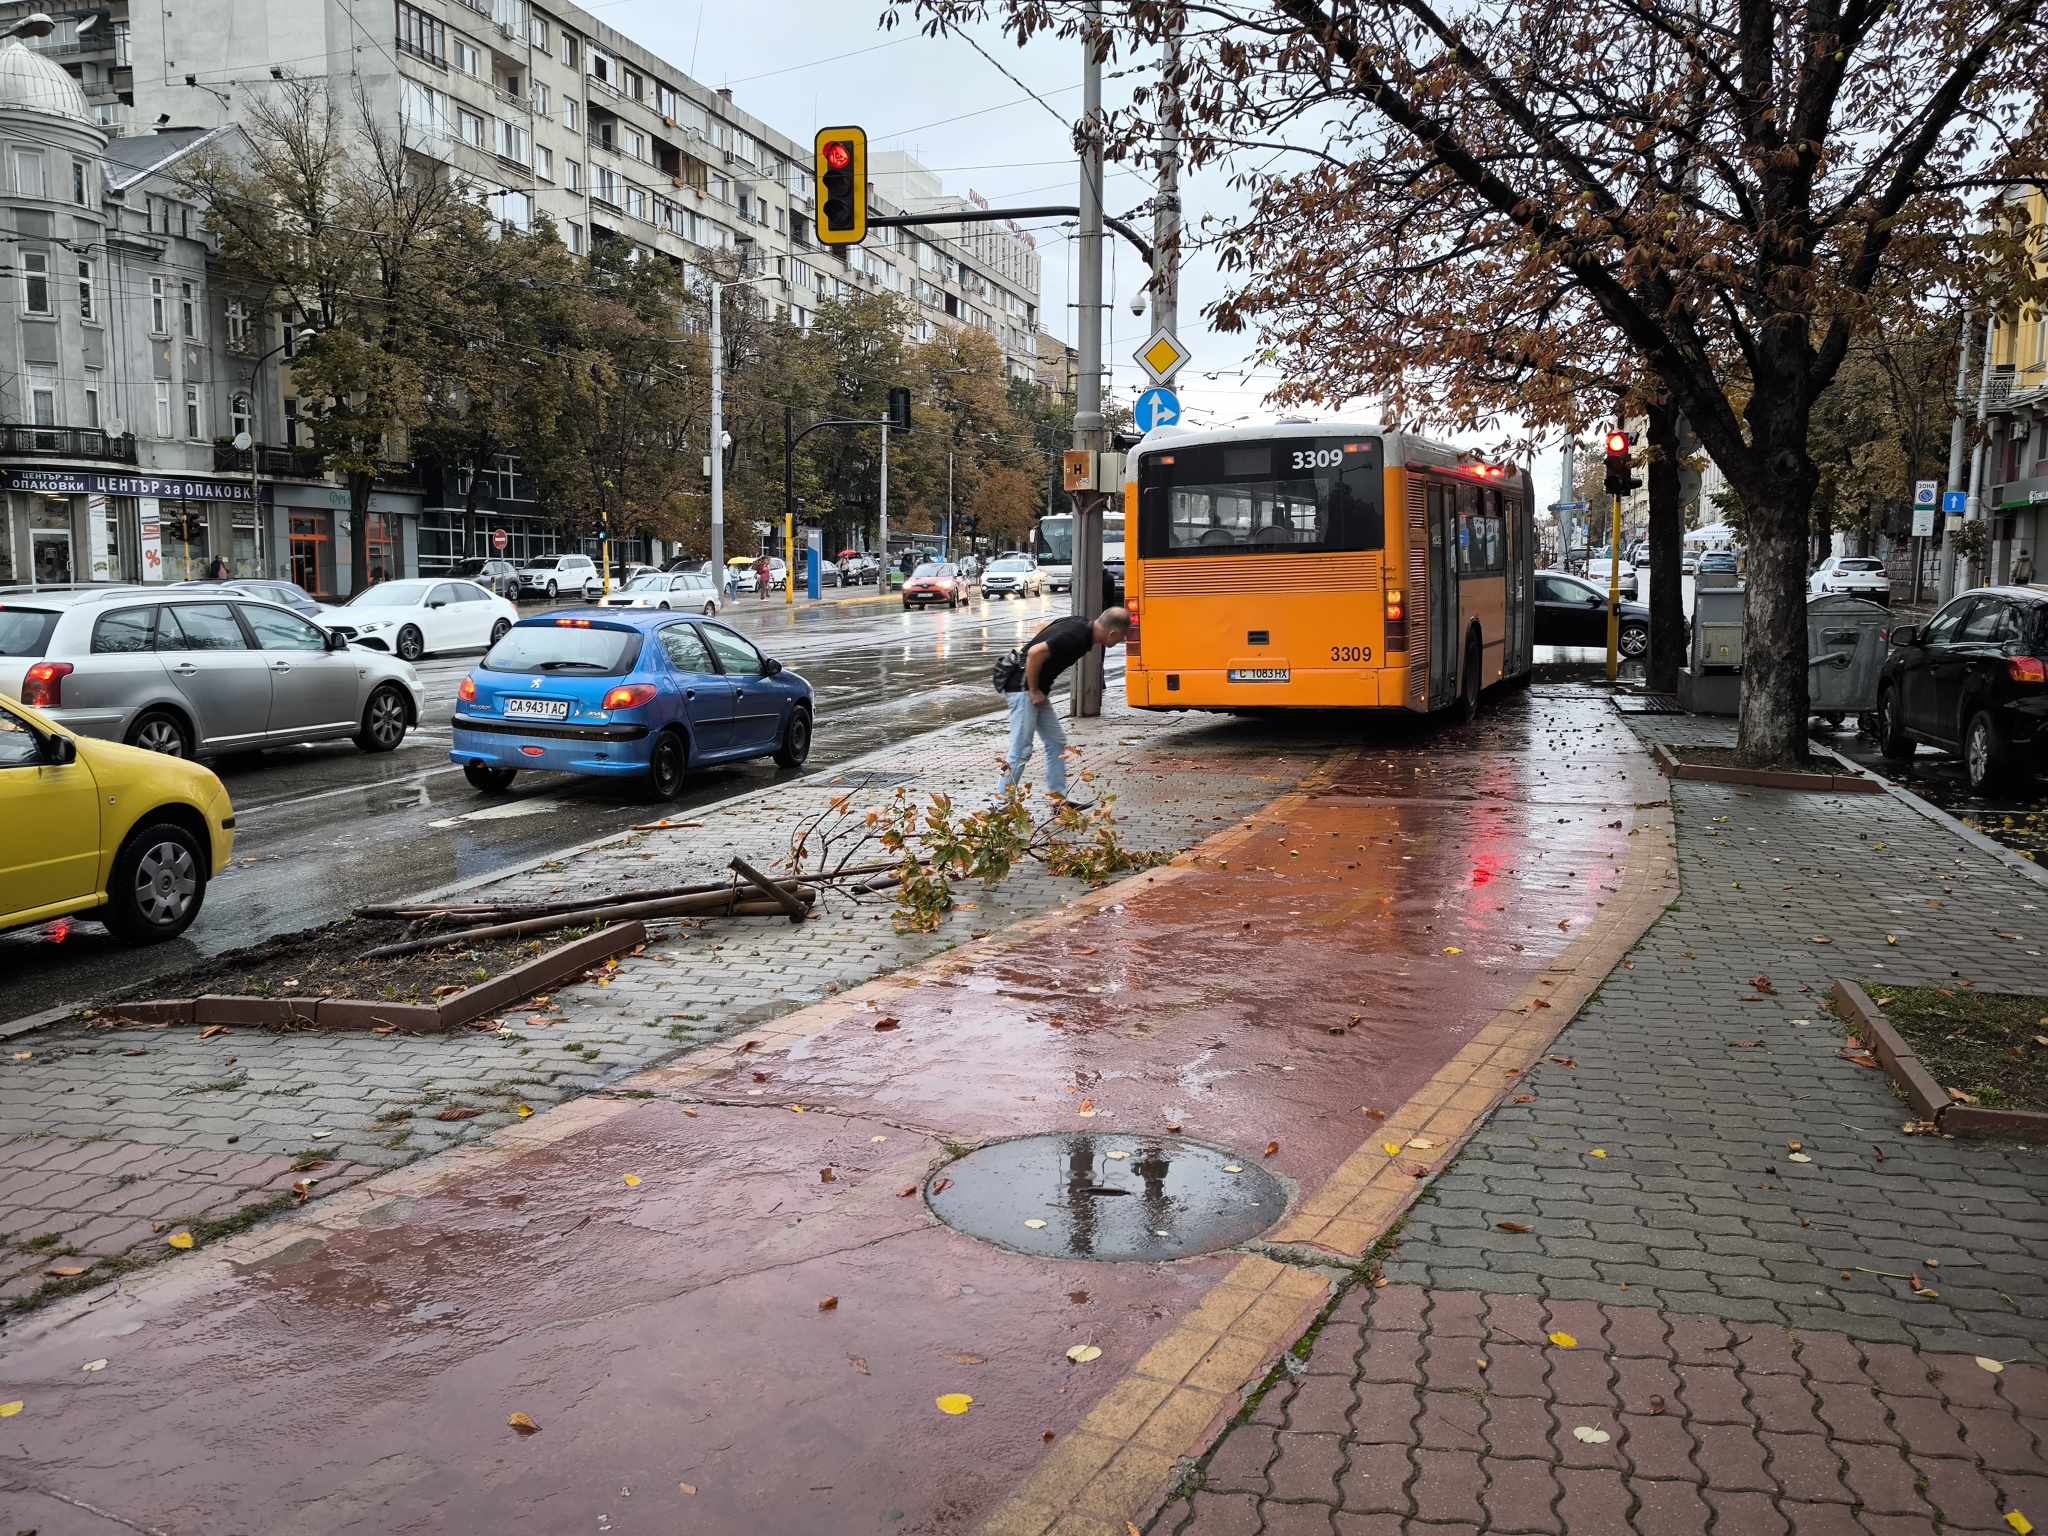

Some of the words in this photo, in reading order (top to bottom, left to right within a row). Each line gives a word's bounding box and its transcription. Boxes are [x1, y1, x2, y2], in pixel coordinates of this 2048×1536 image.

[1292, 449, 1344, 470] 3309
[22, 472, 62, 481] ЦЕНТЪР
[12, 479, 85, 491] ОПАКОВКИ
[97, 477, 160, 494] ЦЕНТЪР
[164, 484, 181, 495] за
[1330, 646, 1372, 662] 3309
[1252, 668, 1274, 678] 1083
[525, 701, 549, 714] 9431
